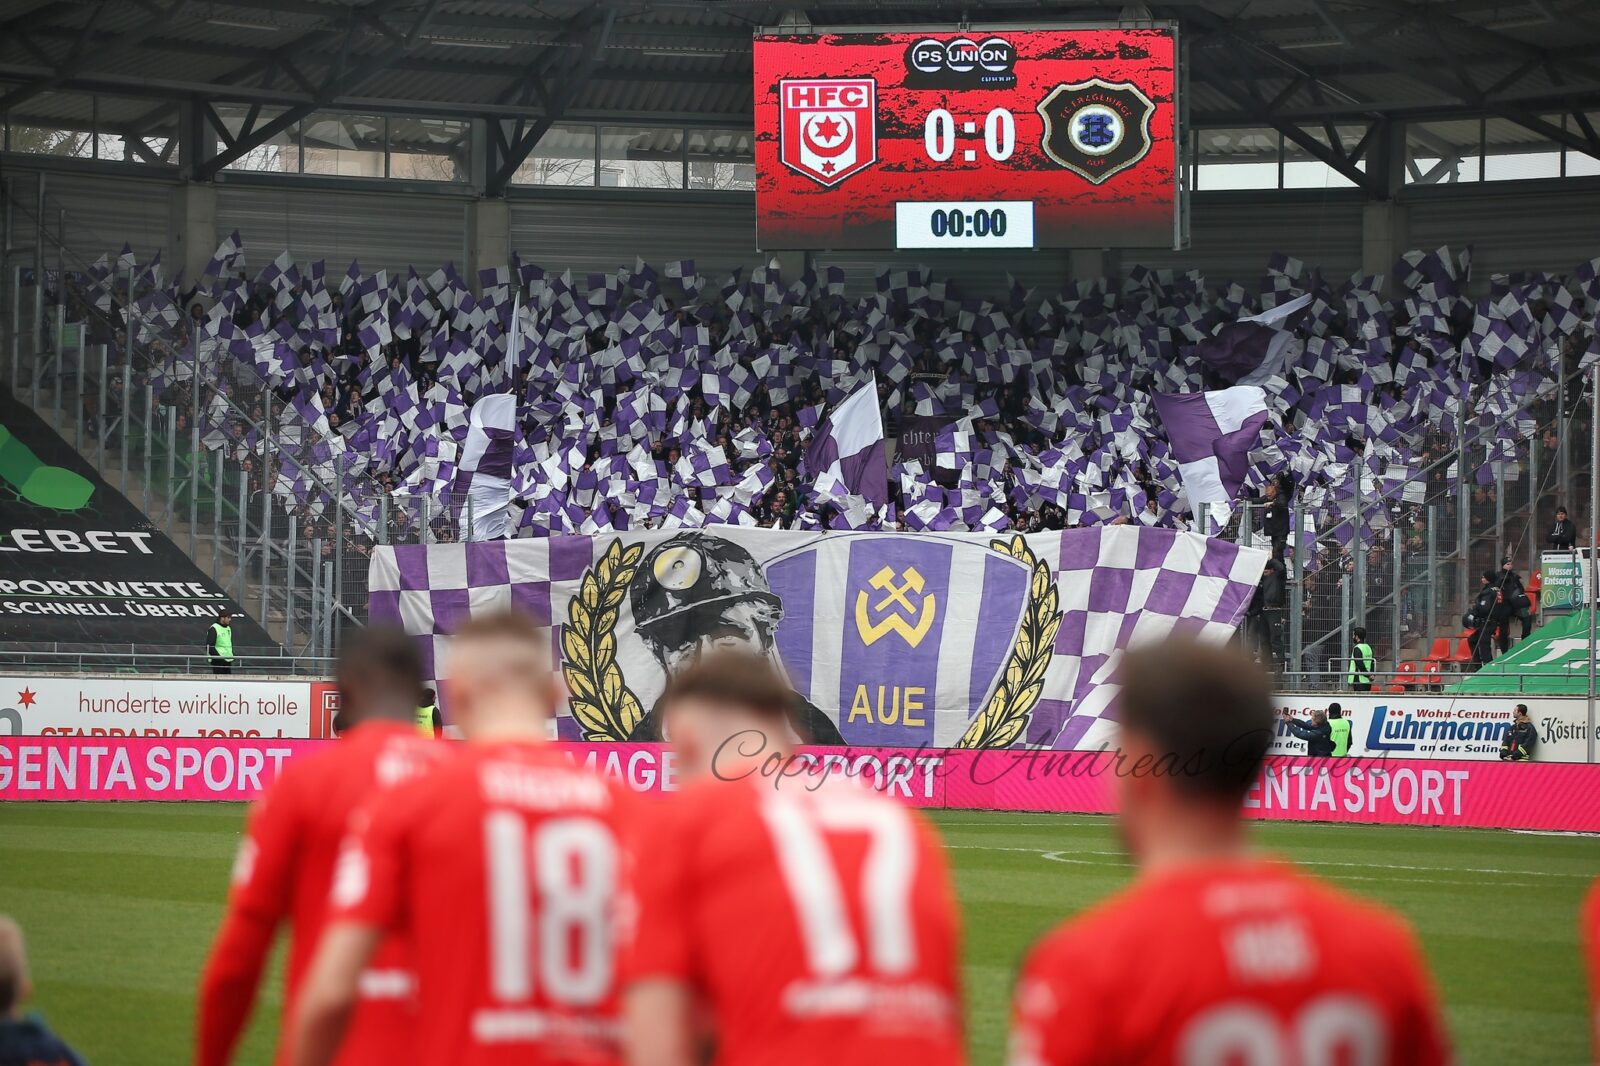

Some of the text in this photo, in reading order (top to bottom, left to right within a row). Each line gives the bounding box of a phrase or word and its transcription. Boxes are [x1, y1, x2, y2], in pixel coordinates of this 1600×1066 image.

[918, 50, 1007, 62] PS UNION
[791, 87, 863, 107] HFC
[924, 107, 1016, 162] 0:0
[930, 208, 1007, 237] 00:00
[1548, 567, 1572, 576] Wasser
[0, 579, 224, 598] PORTWETTE.
[3, 601, 126, 616] SCHNELL.
[79, 691, 298, 716] hunderte wirklich tolle
[847, 684, 926, 727] AUE
[1416, 708, 1510, 720] Wohn-Centrum
[1365, 706, 1512, 751] Lührmann
[1285, 740, 1306, 749] der
[1440, 743, 1461, 753] der
[144, 746, 292, 792] SPORT
[1343, 766, 1470, 816] SPORT
[761, 790, 918, 976] 17
[482, 808, 620, 1008] 18
